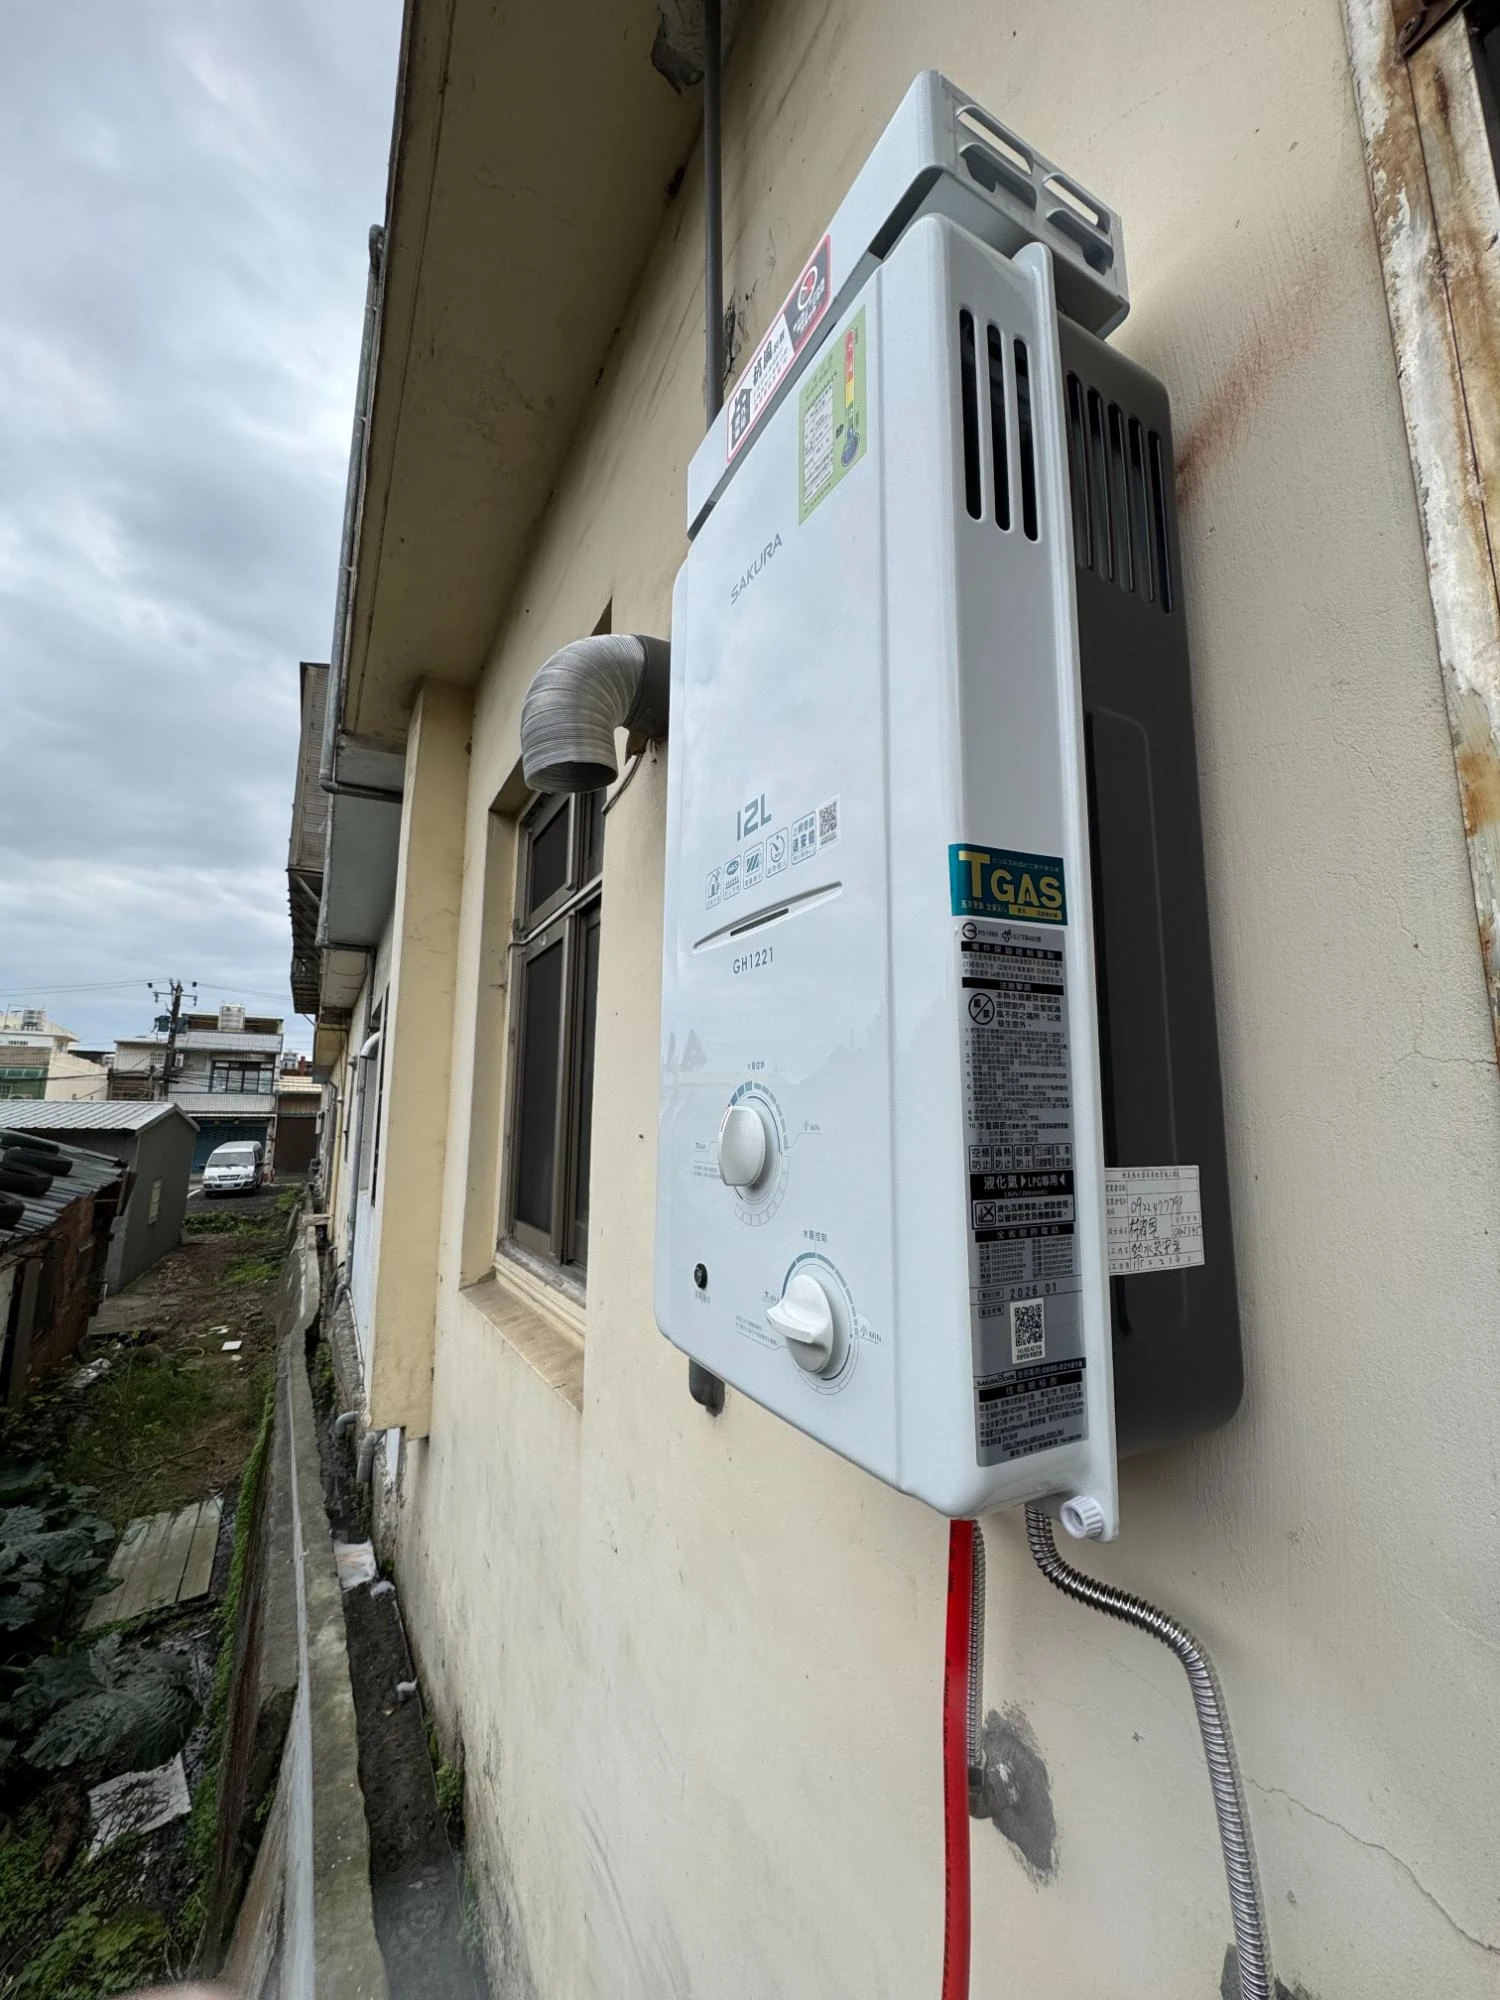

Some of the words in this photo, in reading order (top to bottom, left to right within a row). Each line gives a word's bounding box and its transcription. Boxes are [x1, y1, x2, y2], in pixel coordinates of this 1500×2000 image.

[731, 533, 782, 604] SAKURA
[737, 793, 771, 841] 12L
[733, 947, 773, 974] GH1221
[1011, 1285, 1037, 1299] 2026
[1045, 1282, 1056, 1293] 01
